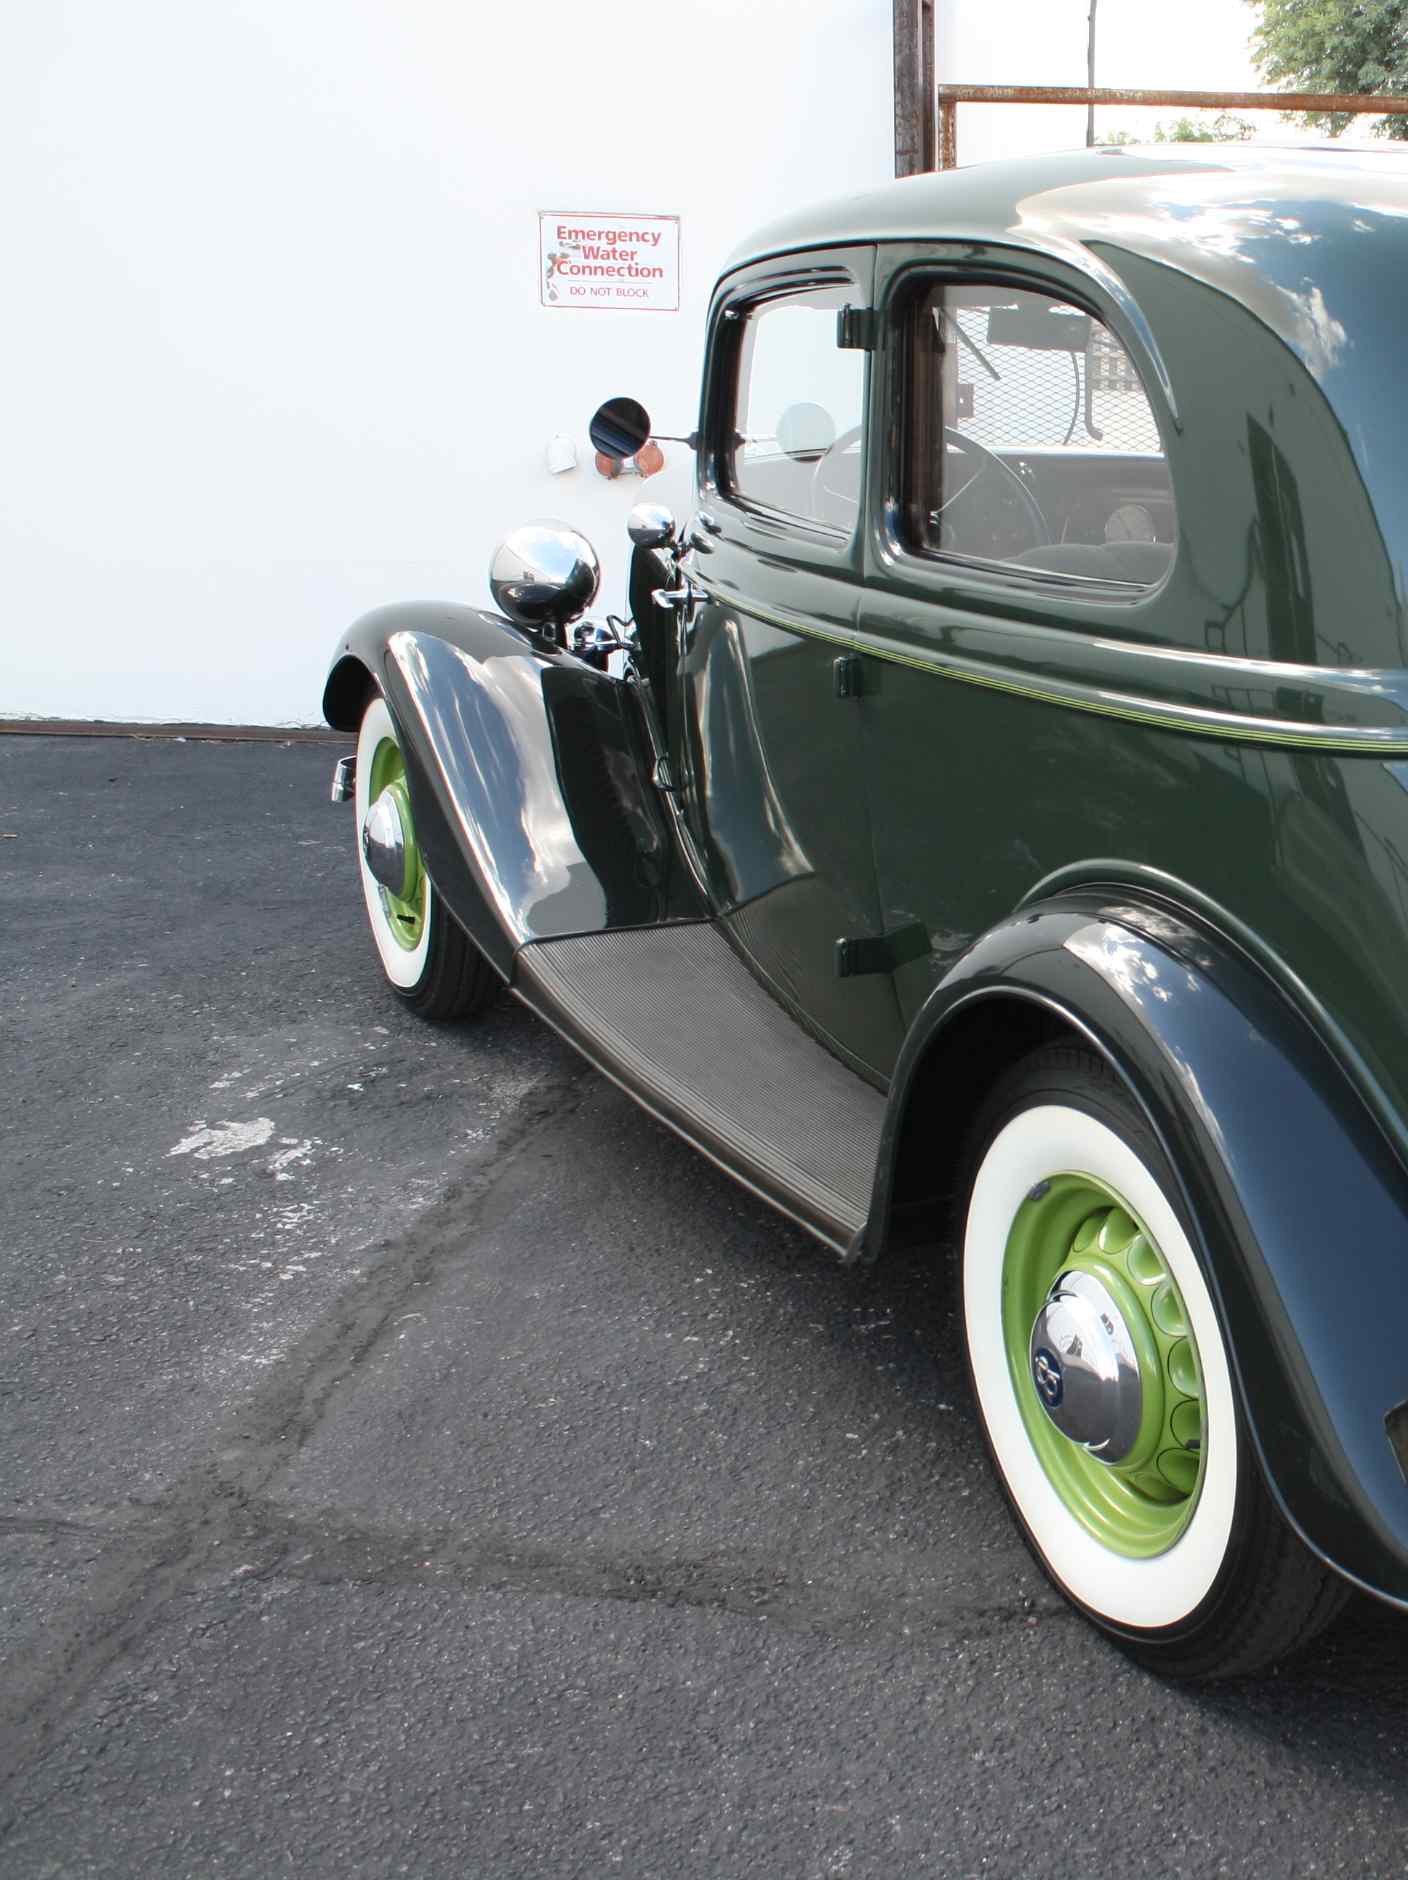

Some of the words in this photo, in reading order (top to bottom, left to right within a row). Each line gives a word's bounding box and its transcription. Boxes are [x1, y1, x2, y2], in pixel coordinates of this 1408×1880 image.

[557, 225, 662, 247] Emergency
[582, 245, 638, 262] Water
[556, 261, 664, 278] Connection
[570, 286, 586, 296] DO
[590, 287, 612, 297] NOT
[616, 287, 649, 298] BLOCK
